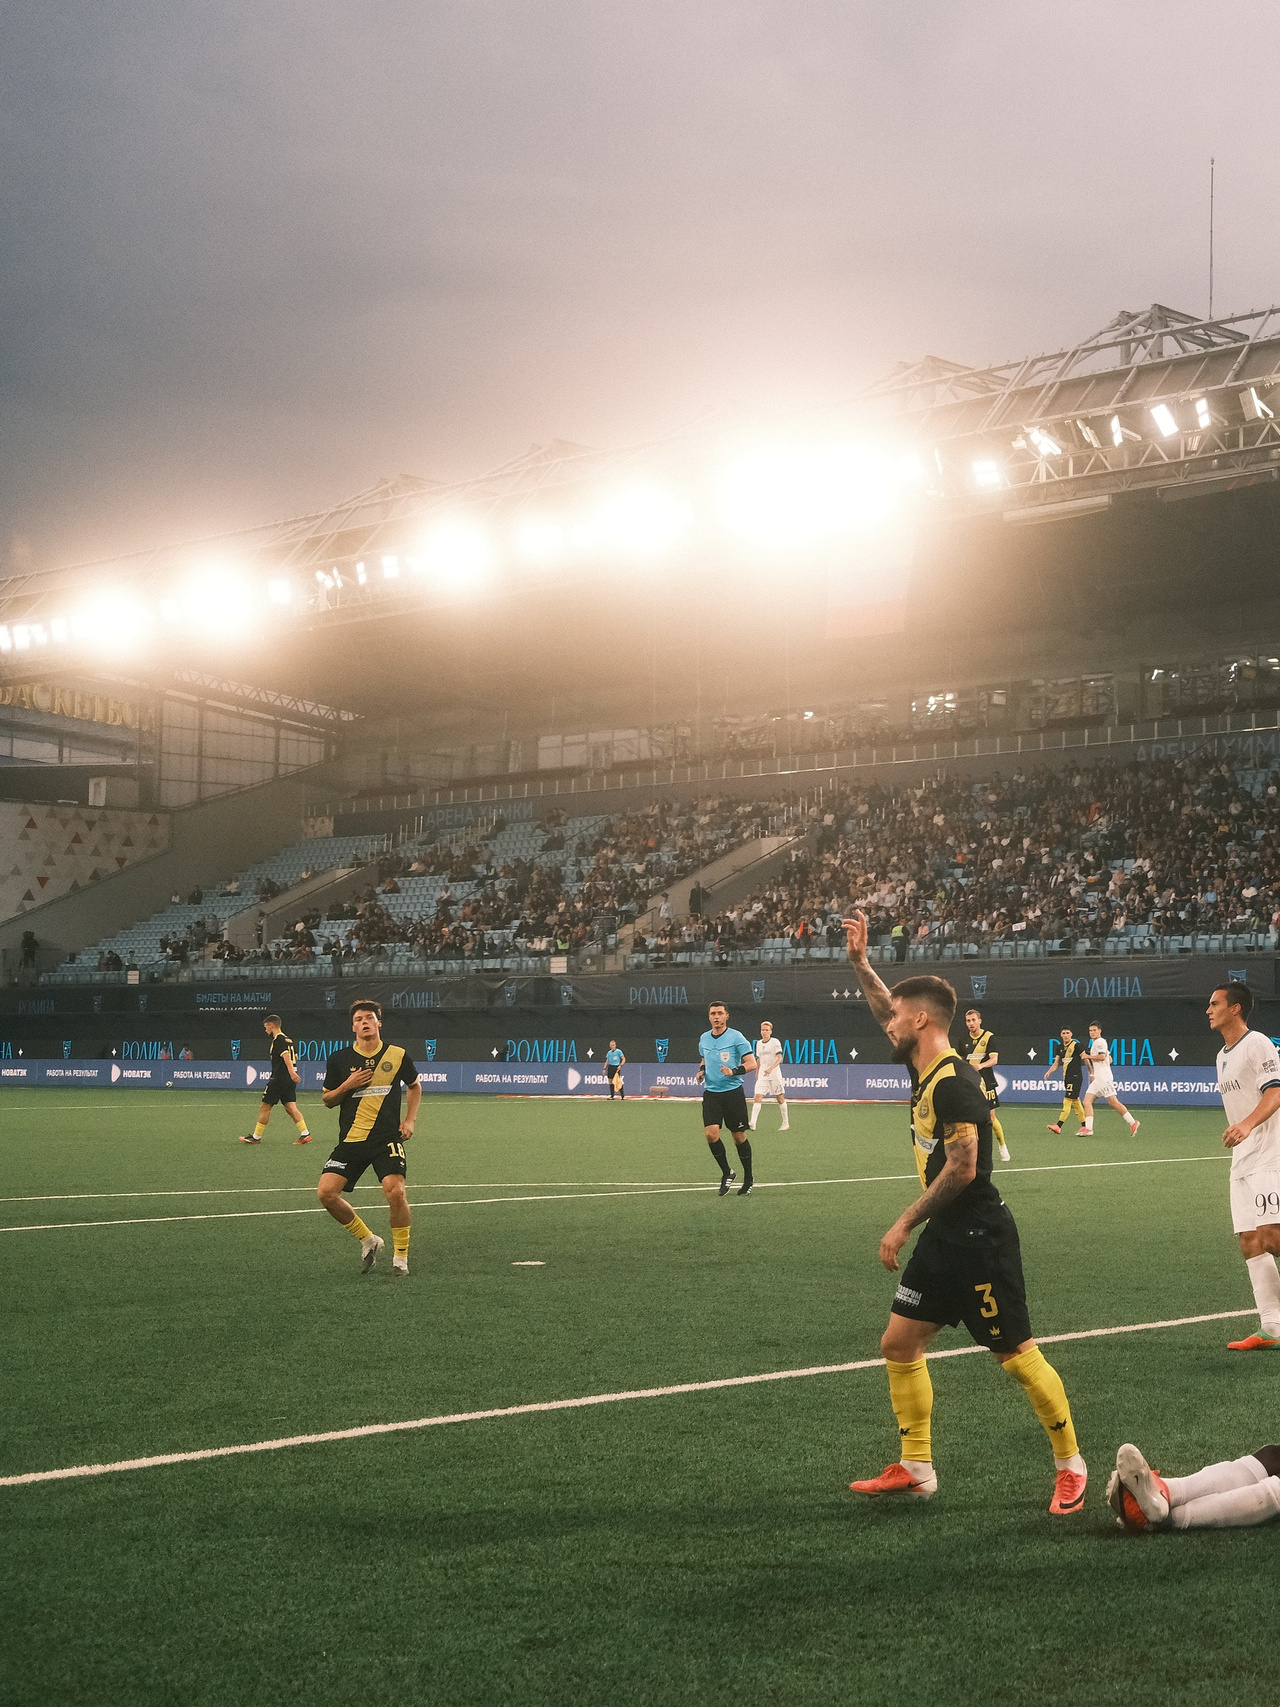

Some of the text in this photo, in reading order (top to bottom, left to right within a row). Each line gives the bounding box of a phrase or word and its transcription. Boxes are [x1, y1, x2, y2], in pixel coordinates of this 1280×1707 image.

[425, 807, 475, 827] АРЕНА
[196, 992, 272, 1003] БИЛЕТЫ НА МАТЧИ
[1, 1069, 27, 1077] НОВАТЭК
[123, 1071, 151, 1079] НОВАТЭК
[173, 1071, 231, 1079] РАБОТА НА РЕЗУЛЬТАТ
[419, 1073, 447, 1082] ОВАТЭК
[475, 1074, 549, 1084] РАБОТА НА РЕЗУЛЬТАТ
[584, 1075, 625, 1084] НОВАК
[656, 1076, 685, 1086] РАБОТА
[782, 1078, 829, 1088] НОВАТЭК
[866, 1079, 899, 1089] РАБОТА
[1012, 1080, 1066, 1091] НОВАТЭК
[1113, 1081, 1151, 1092] РАБОТА
[1153, 1082, 1168, 1092] НА
[1170, 1082, 1220, 1093] РЕЗУЛЬТА
[387, 1142, 406, 1159] 18
[1255, 1191, 1280, 1217] 99
[974, 1283, 998, 1318] 3
